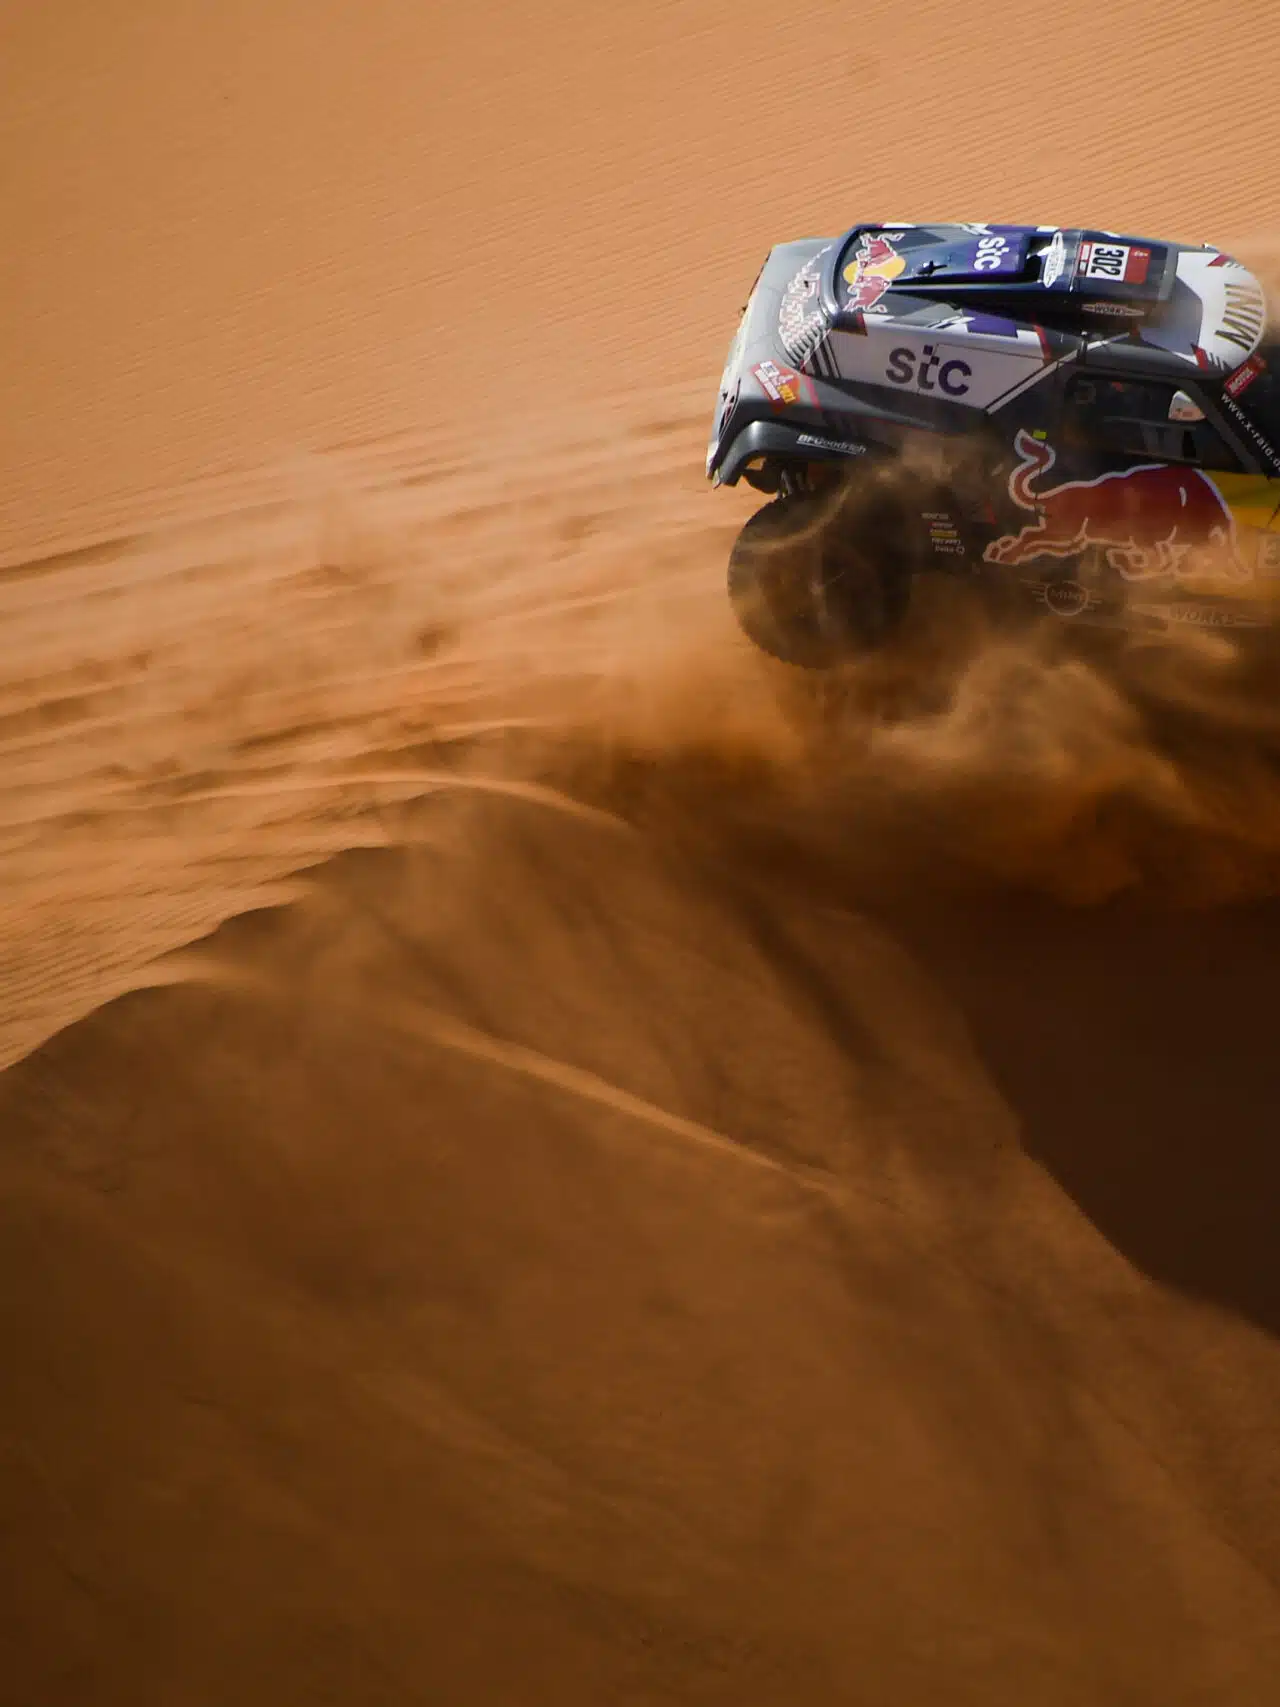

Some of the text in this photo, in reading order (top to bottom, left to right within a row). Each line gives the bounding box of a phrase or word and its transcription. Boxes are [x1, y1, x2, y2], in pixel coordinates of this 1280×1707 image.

[973, 236, 1009, 271] stc
[1090, 247, 1125, 277] 302
[1214, 283, 1264, 352] MINI
[885, 345, 972, 396] stc
